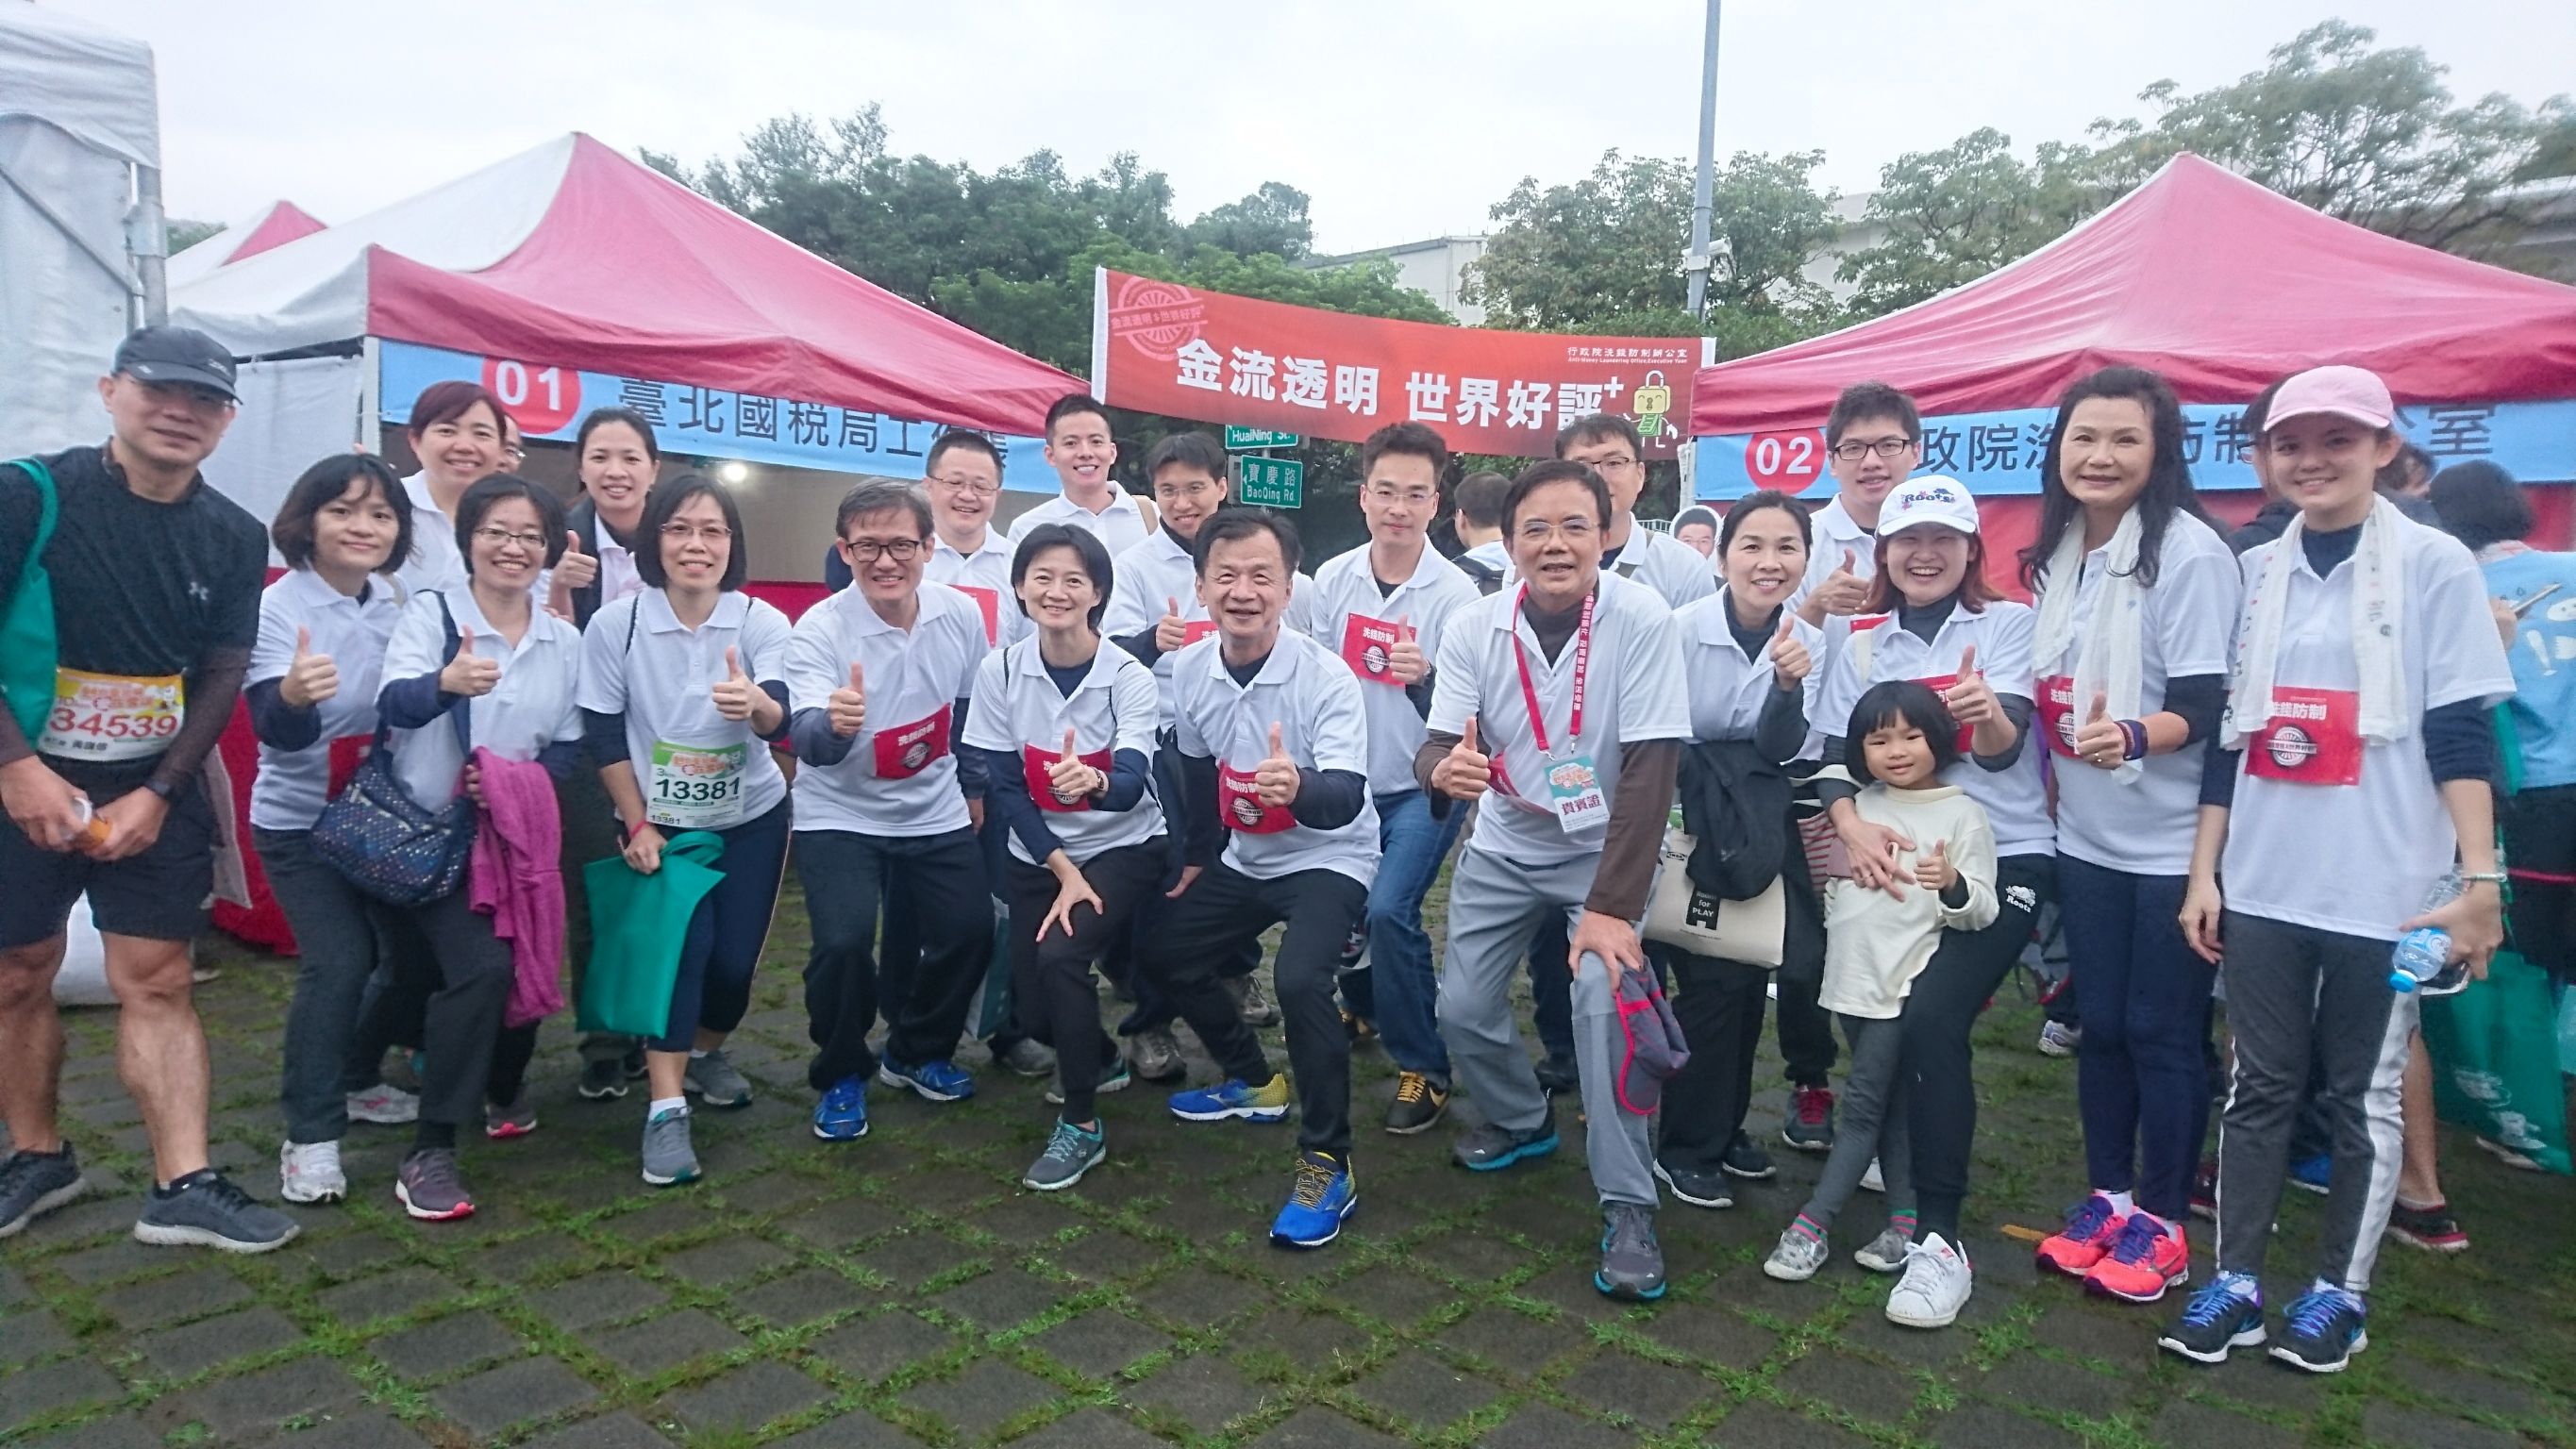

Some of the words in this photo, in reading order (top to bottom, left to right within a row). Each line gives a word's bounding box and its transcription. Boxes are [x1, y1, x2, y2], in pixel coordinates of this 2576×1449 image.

[495, 359, 561, 410] 01
[1177, 338, 1380, 415] 金流透明
[1231, 429, 1273, 444] HuaiNing
[1754, 436, 1814, 475] 02
[1247, 462, 1296, 487] 寶慶路
[1246, 485, 1280, 504] BaoQing
[1904, 493, 1952, 503] Roots
[50, 708, 177, 738] 34539
[655, 776, 741, 800] 13381
[1562, 793, 1602, 816] 貴賓證
[650, 814, 681, 825] 13381
[1692, 907, 1715, 917] PLAY
[1698, 899, 1712, 908] for
[2006, 894, 2032, 913] Roots
